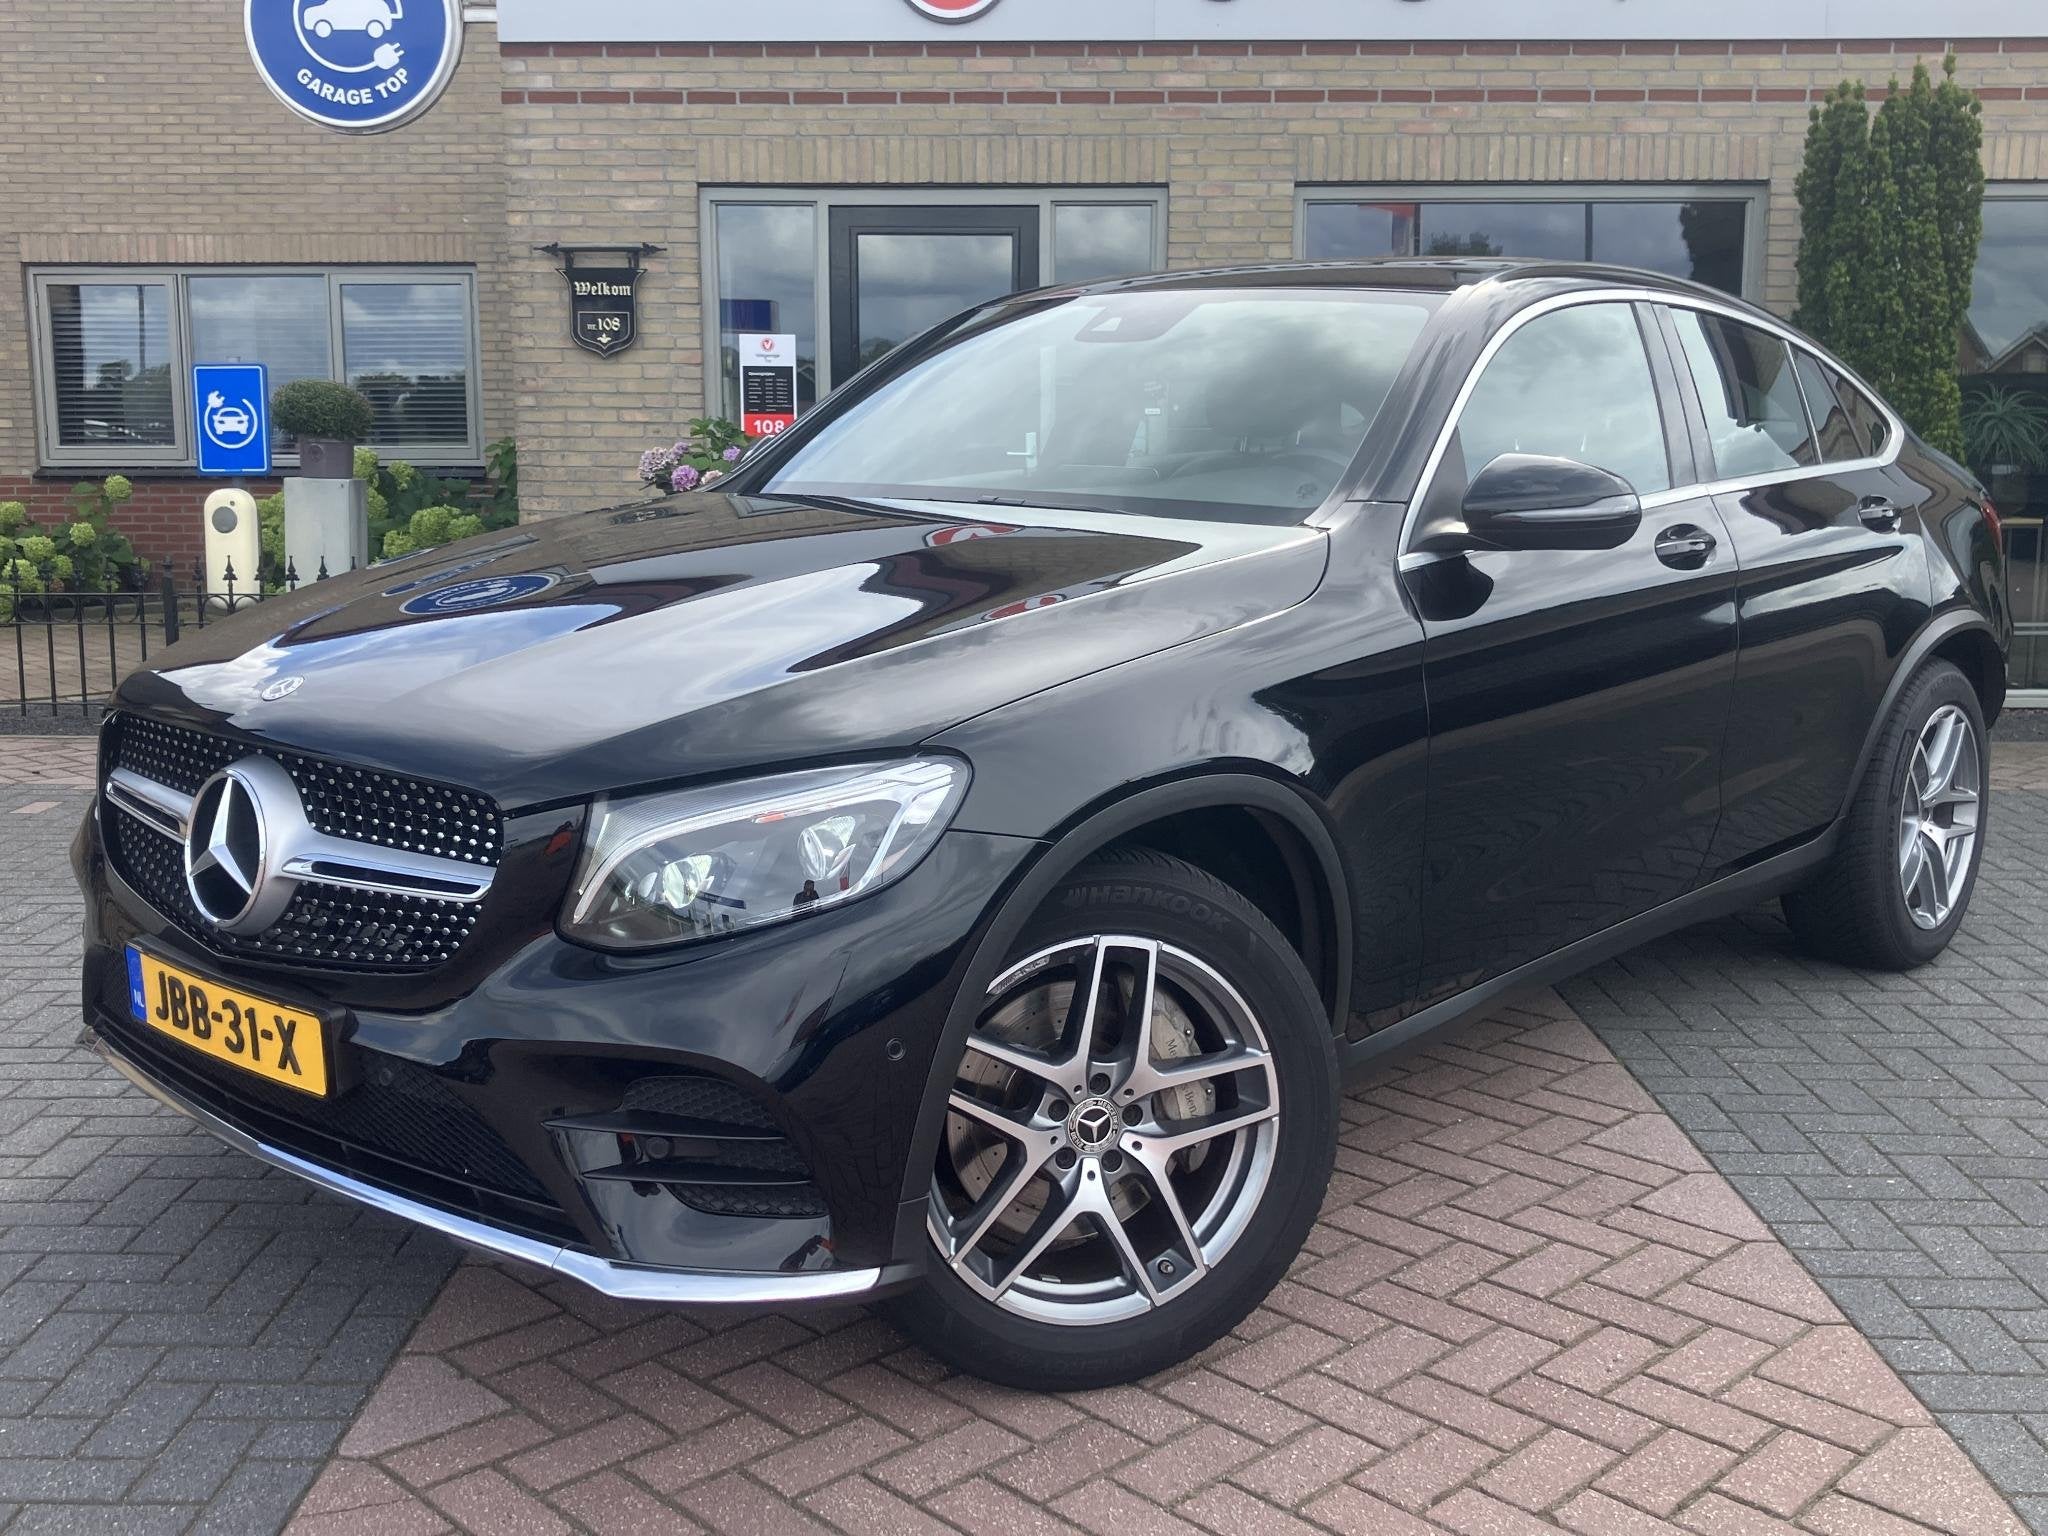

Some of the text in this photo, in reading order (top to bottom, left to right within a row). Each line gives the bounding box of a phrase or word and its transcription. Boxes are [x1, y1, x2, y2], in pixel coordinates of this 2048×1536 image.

[296, 67, 408, 105] GARAGE TOP
[574, 281, 632, 295] Welkom
[597, 317, 621, 331] 108
[753, 419, 785, 434] 108
[133, 988, 144, 1008] NL
[156, 971, 302, 1075] JBB-31-X
